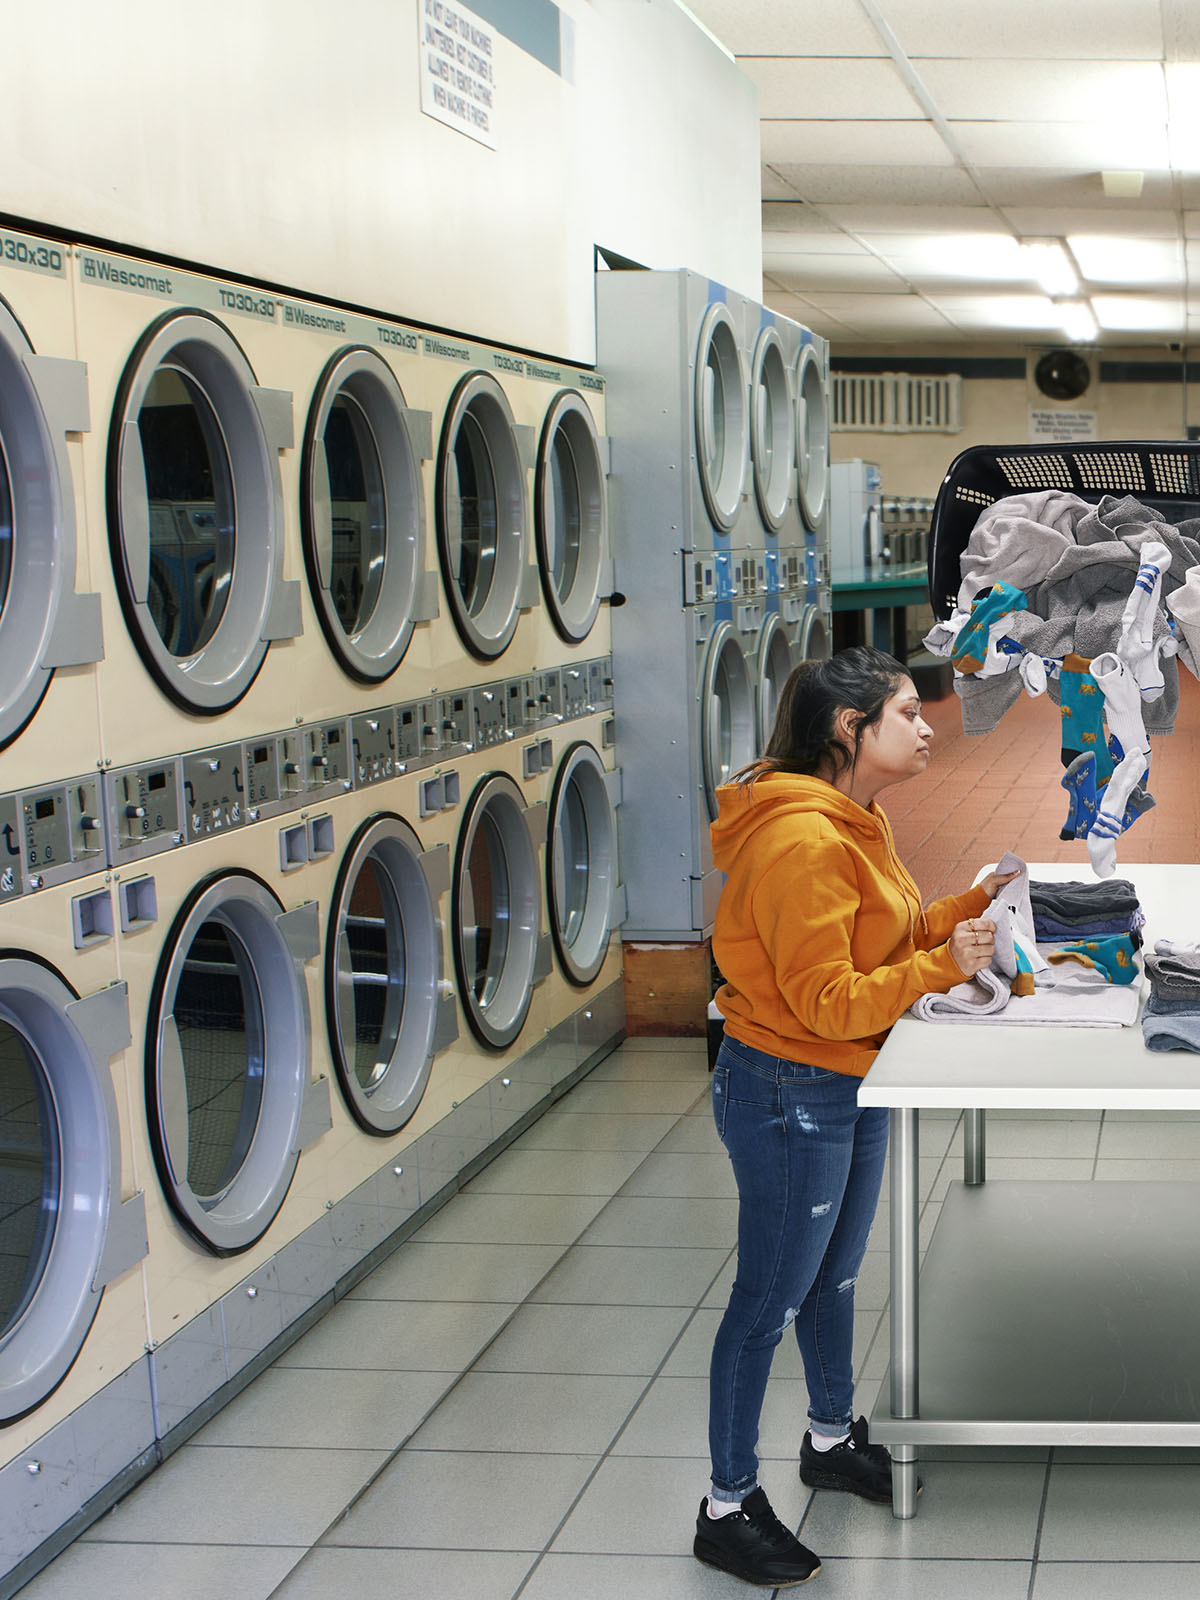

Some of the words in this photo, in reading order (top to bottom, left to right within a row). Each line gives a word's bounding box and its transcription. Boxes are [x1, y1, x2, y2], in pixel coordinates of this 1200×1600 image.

[0, 238, 61, 270] 30x30
[95, 257, 172, 294] Wascomat
[218, 288, 275, 317] TD30x30
[294, 305, 346, 333] Wascomat
[377, 326, 417, 350] TD30x30
[431, 341, 470, 361] Wascomat
[493, 354, 523, 373] TD30x30
[531, 364, 561, 381] Wascomat
